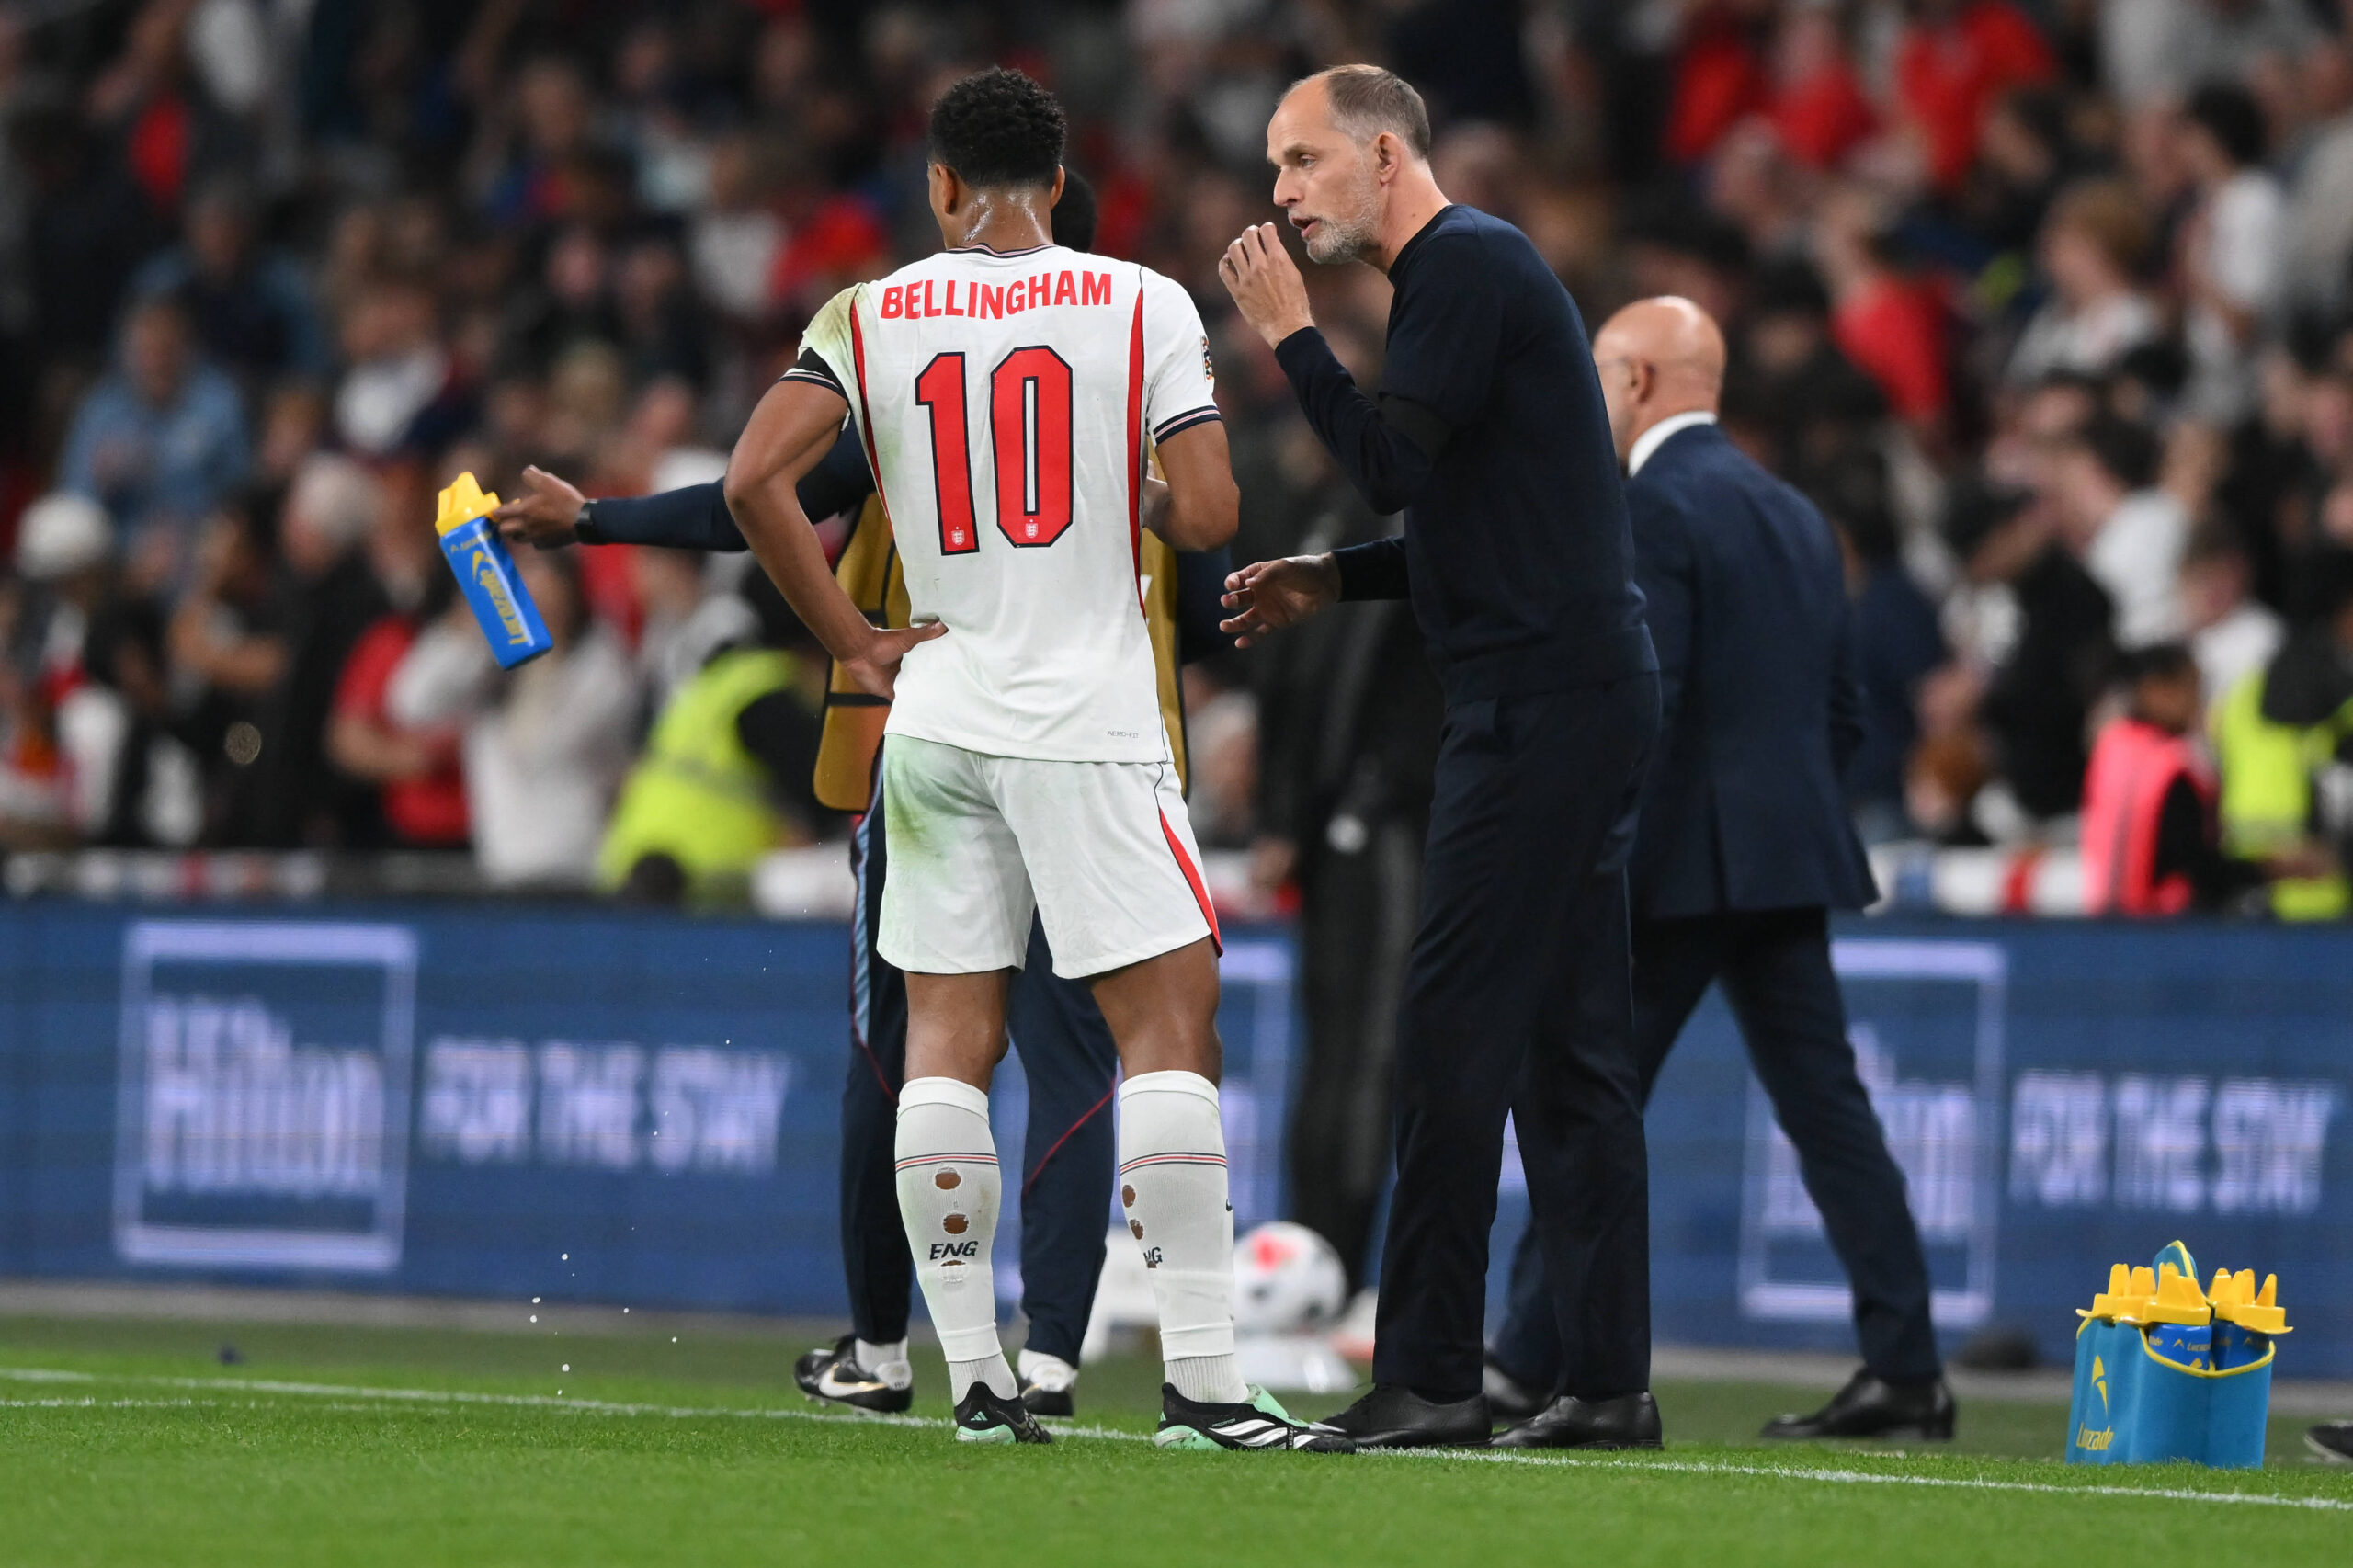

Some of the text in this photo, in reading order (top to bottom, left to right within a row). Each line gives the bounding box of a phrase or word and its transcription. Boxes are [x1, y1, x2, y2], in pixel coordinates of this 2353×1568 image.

[881, 270, 1112, 320] BELLINGHAM
[915, 345, 1074, 556] 10
[423, 1038, 790, 1173] FOR THE STAY
[2012, 1072, 2105, 1205] FOR
[2116, 1074, 2206, 1209] THE
[2213, 1079, 2331, 1213] STAY
[929, 1241, 979, 1260] ENG
[1142, 1246, 1163, 1264] NG
